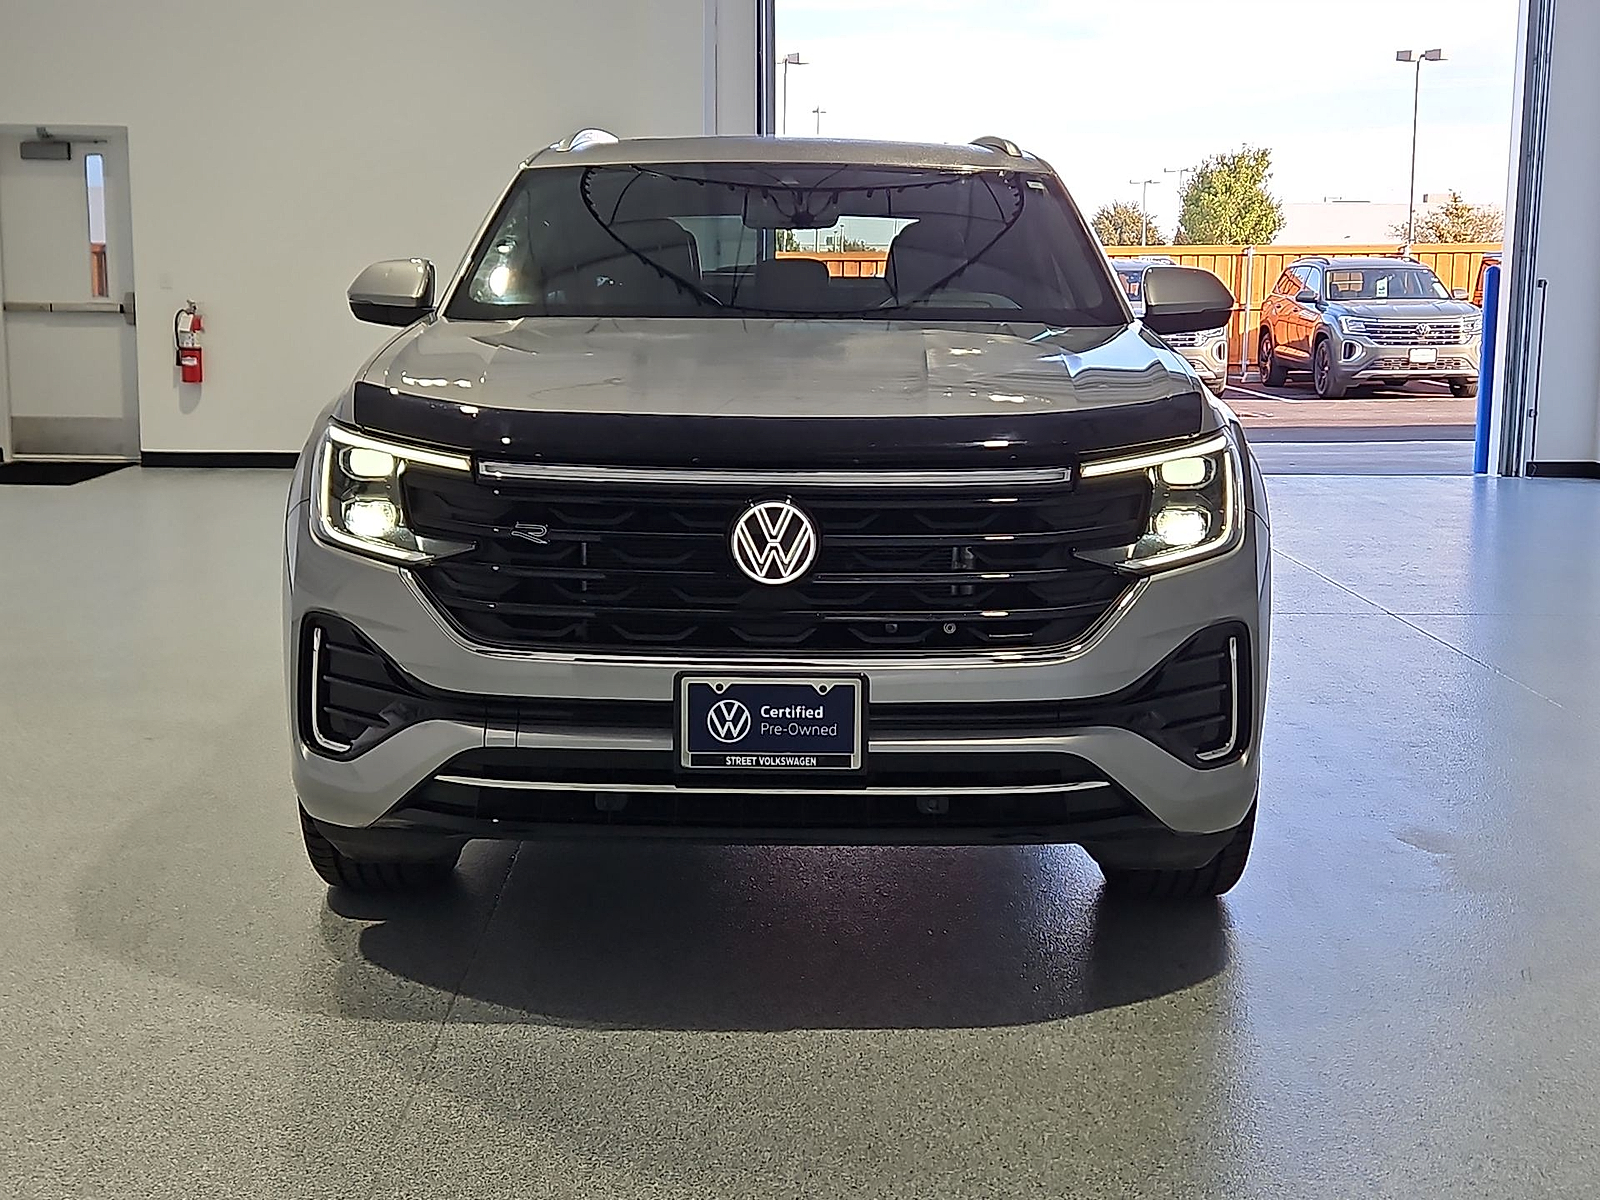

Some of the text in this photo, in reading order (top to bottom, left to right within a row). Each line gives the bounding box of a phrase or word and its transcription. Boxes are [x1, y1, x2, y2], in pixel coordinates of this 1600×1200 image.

[760, 705, 824, 719] Certified
[760, 722, 838, 736] Pre-Owned
[725, 756, 817, 766] STREET VOLKSWAGEN
